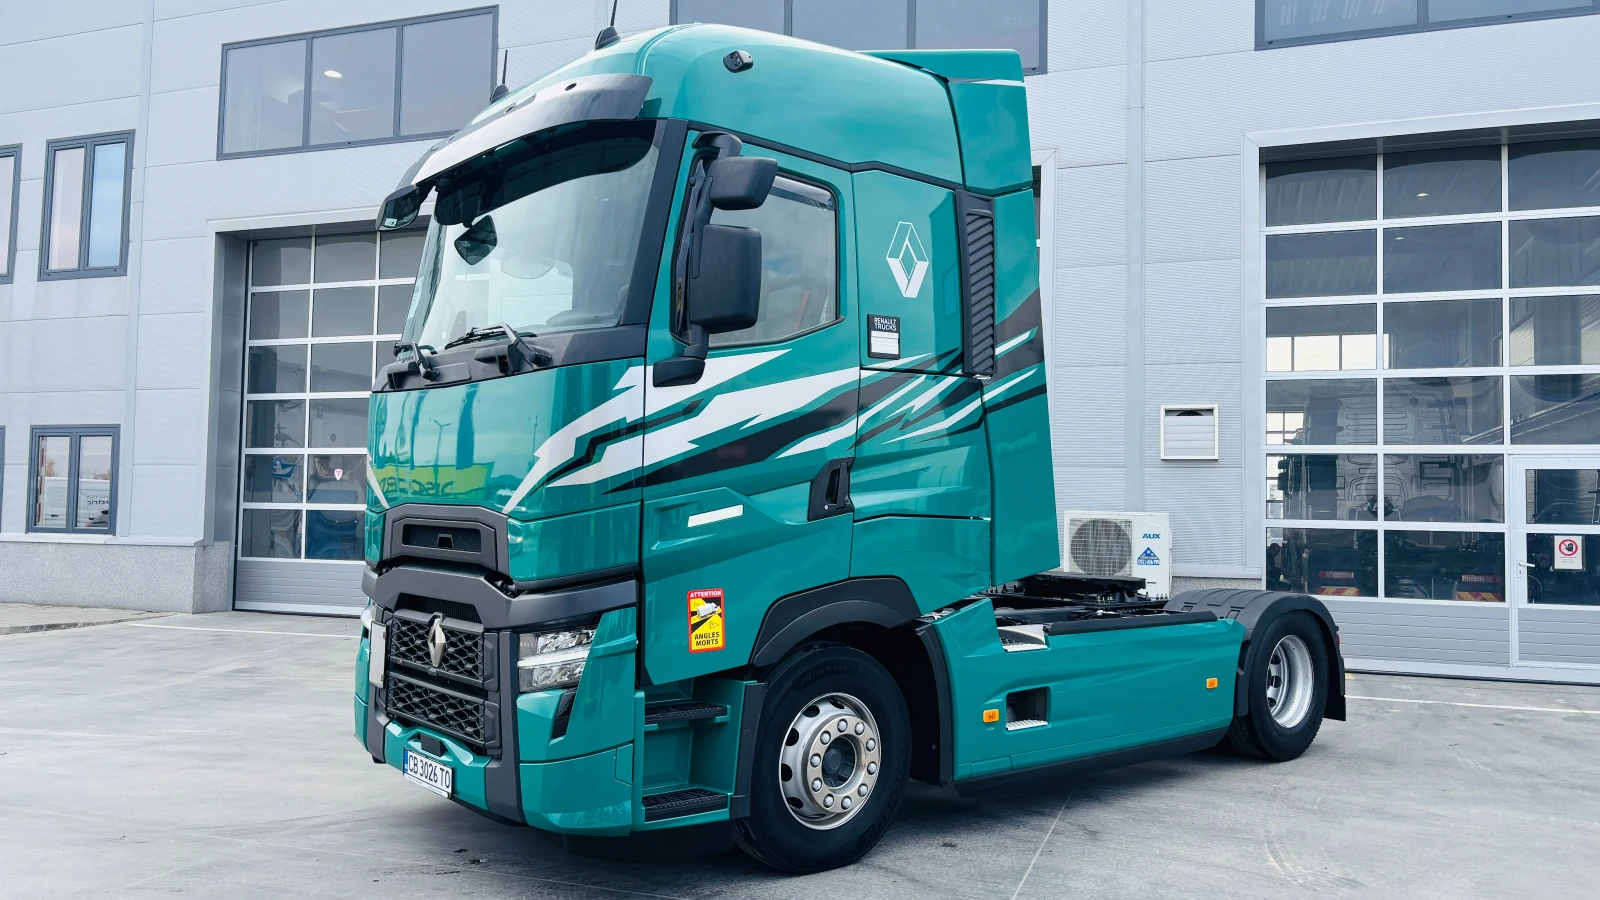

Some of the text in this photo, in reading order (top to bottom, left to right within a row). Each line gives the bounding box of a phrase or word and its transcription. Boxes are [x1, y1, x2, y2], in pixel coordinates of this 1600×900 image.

[873, 317, 897, 325] RENAULT
[874, 323, 897, 331] TRUCKS
[690, 590, 722, 598] ATTENTION
[694, 631, 720, 640] ANGLES
[695, 638, 719, 647] MORTS
[408, 754, 419, 775] CB
[419, 759, 438, 784] 3026
[439, 767, 451, 789] TO
